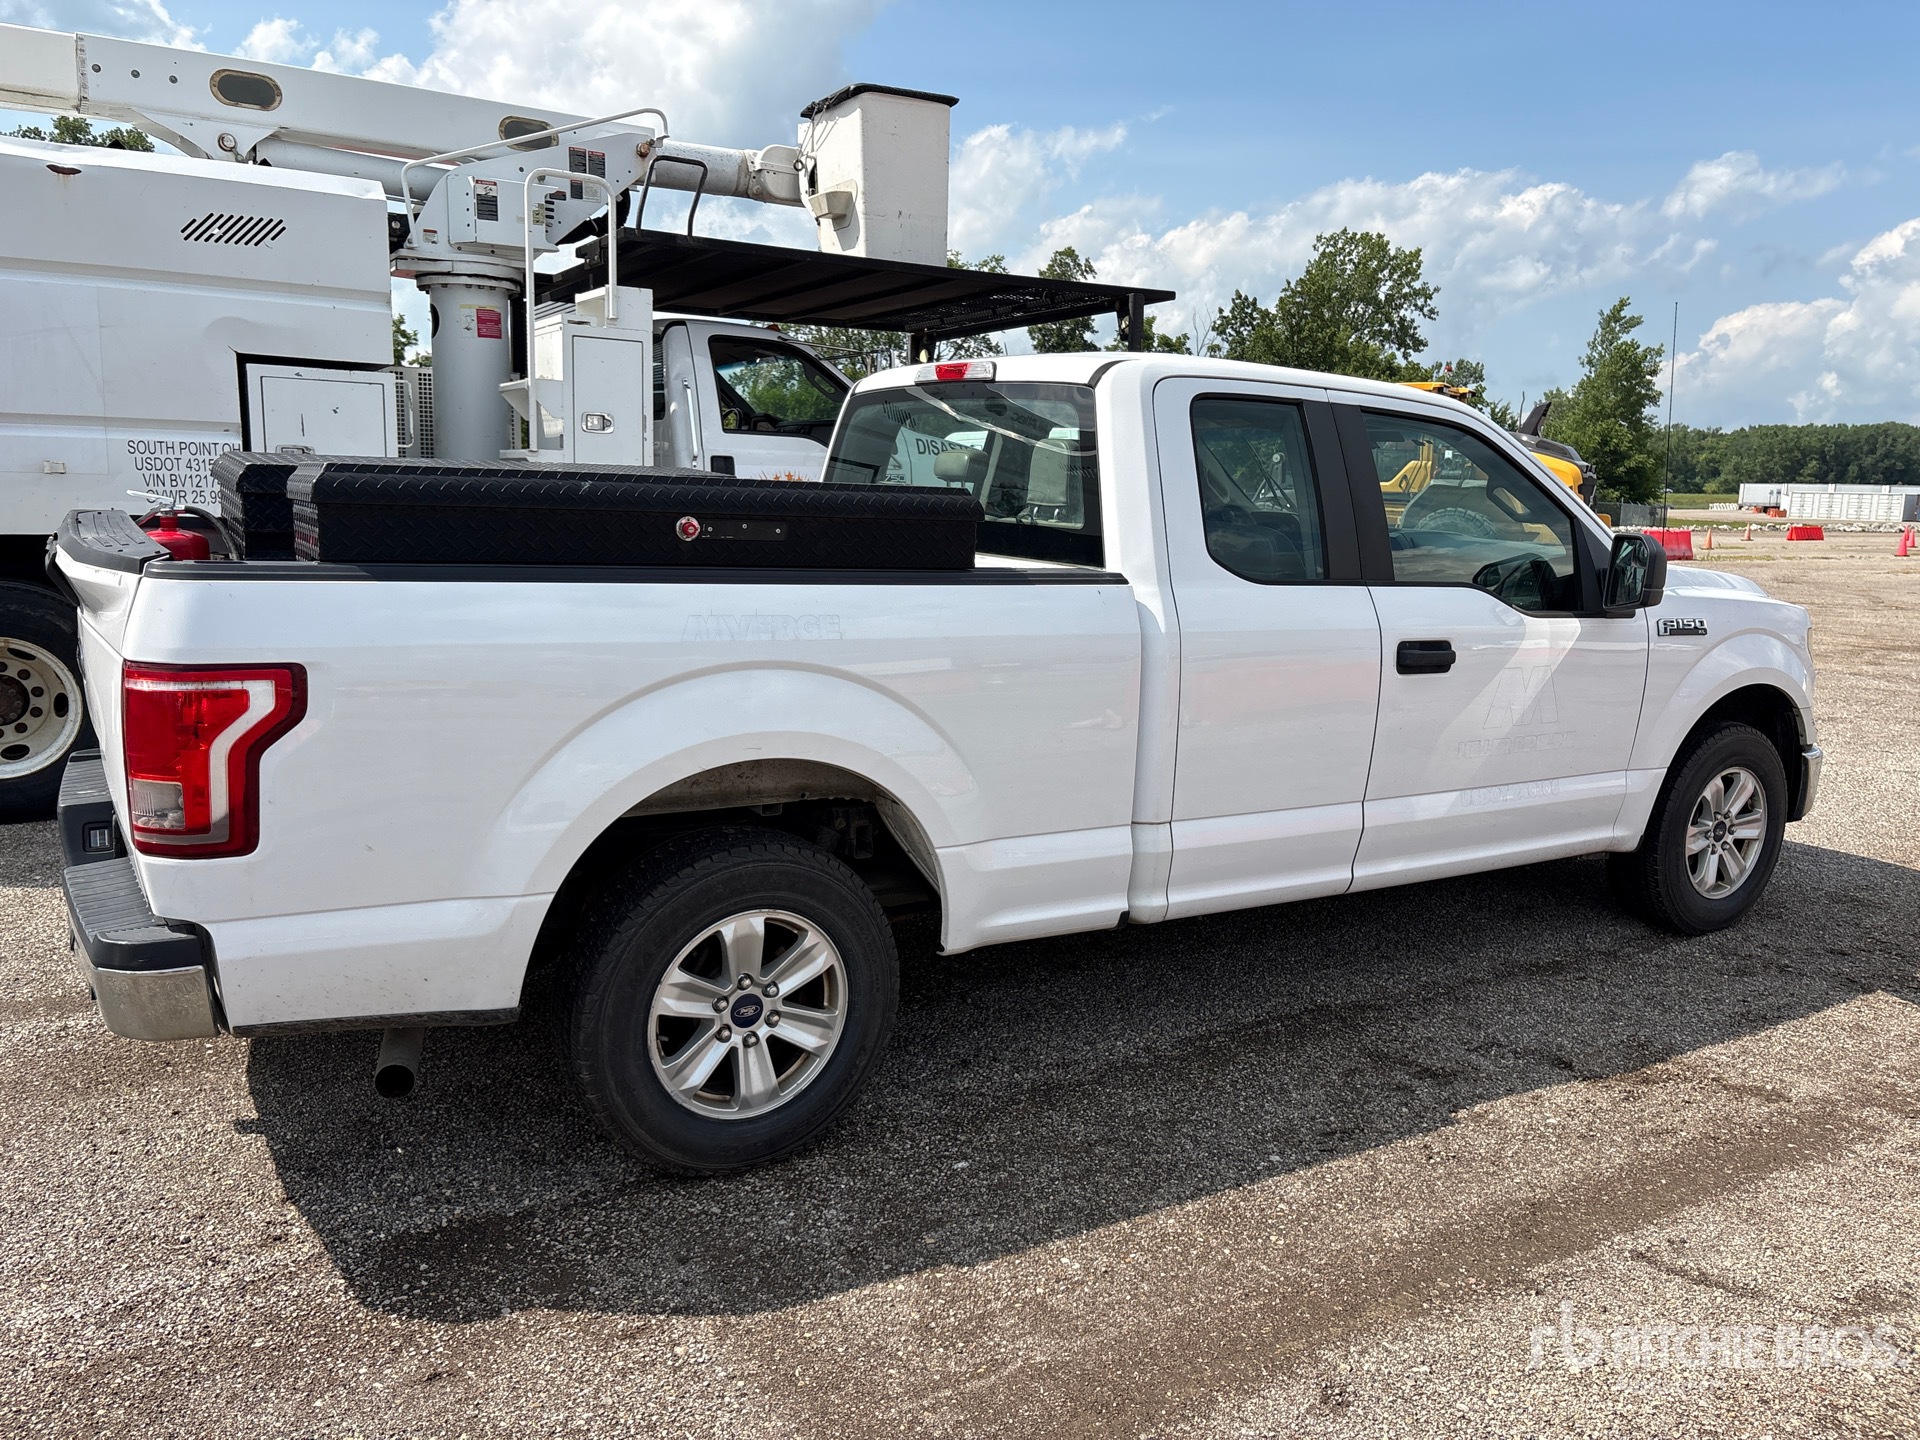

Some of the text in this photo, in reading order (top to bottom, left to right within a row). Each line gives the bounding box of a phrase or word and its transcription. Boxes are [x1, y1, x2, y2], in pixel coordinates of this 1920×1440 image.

[127, 439, 175, 455] SOUTH
[179, 441, 219, 456] POINT
[134, 456, 182, 471] USDOT
[142, 473, 166, 487] VIN
